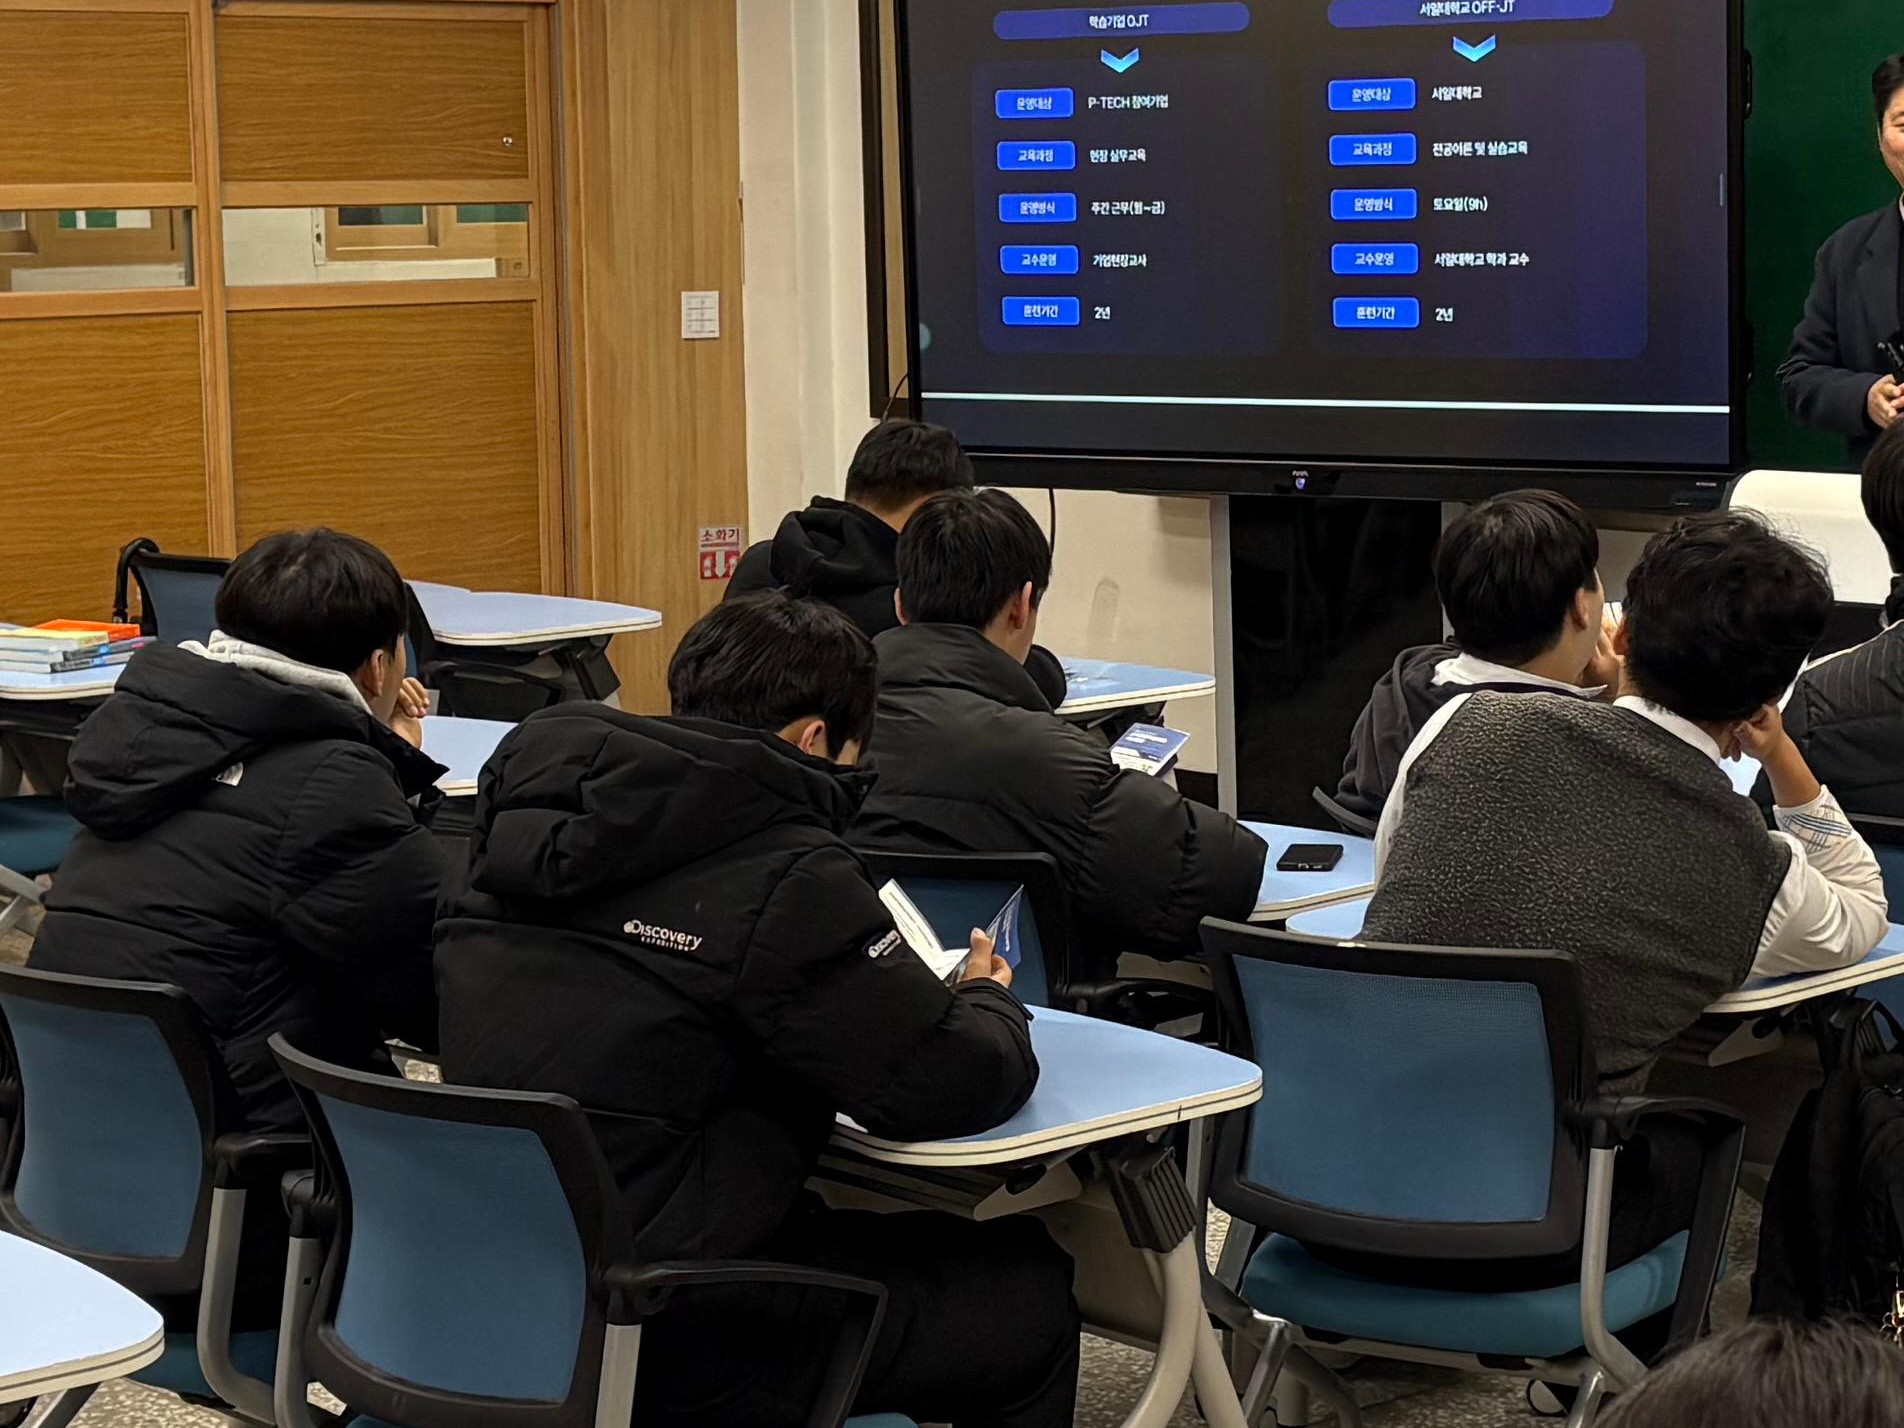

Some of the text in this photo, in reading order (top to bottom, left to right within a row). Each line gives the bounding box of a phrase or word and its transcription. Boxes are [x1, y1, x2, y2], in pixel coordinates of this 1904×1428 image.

[1127, 14, 1150, 28] OJT
[1088, 96, 1130, 109] P-TECH
[1509, 252, 1530, 266] 교수
[1094, 306, 1111, 320] 2년
[1435, 307, 1453, 322] 2년
[701, 528, 740, 542] 소화기
